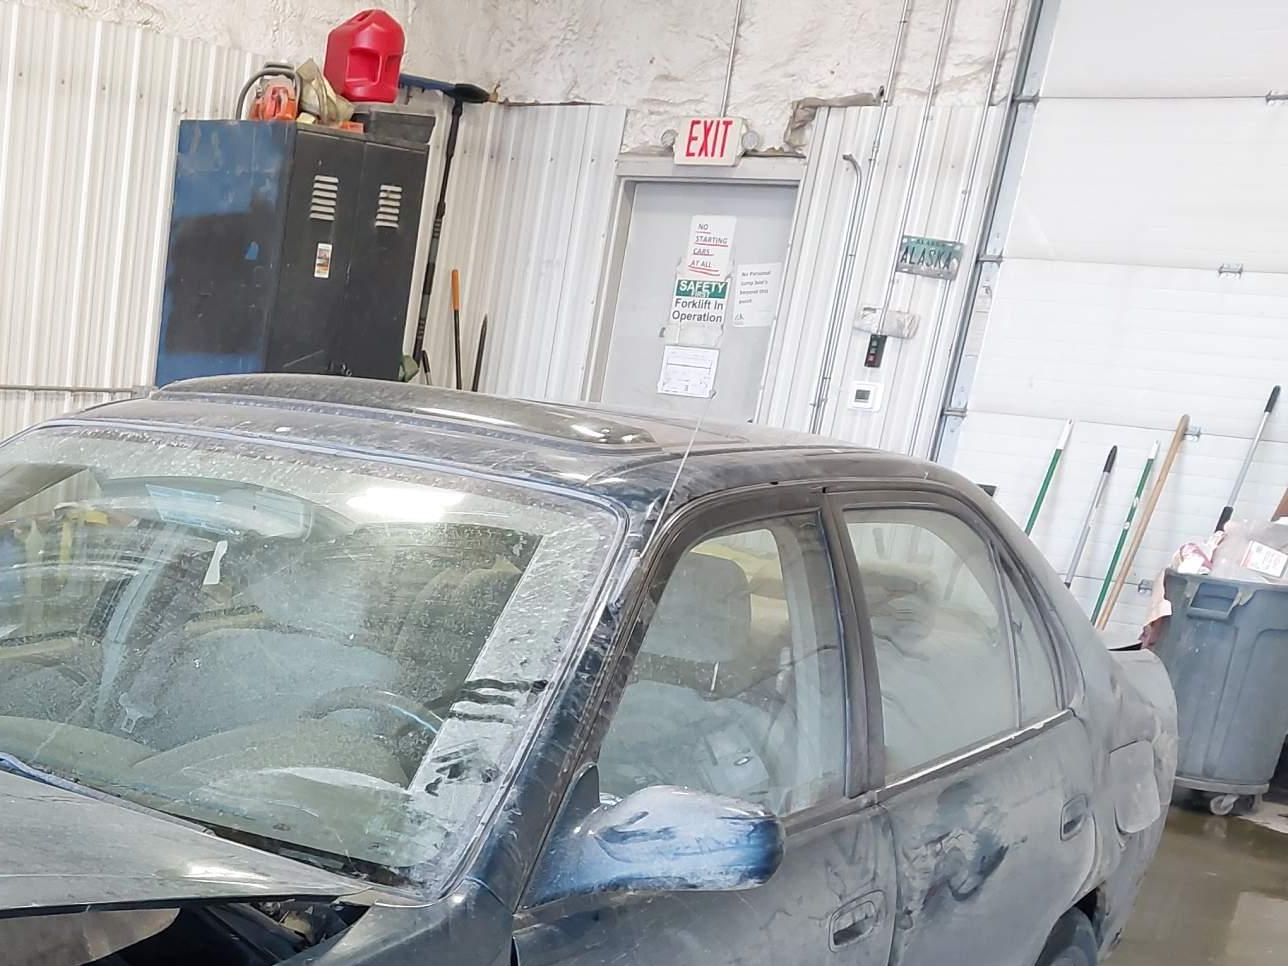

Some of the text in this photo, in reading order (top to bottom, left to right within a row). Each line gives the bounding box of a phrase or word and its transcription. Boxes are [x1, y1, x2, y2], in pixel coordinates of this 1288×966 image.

[685, 120, 733, 157] EXIT
[695, 236, 728, 245] STARTING
[693, 248, 710, 256] CARS
[900, 245, 953, 270] ALASKA
[679, 280, 726, 294] SAFETY
[675, 298, 724, 310] Forklift In
[672, 310, 723, 323] Operation
